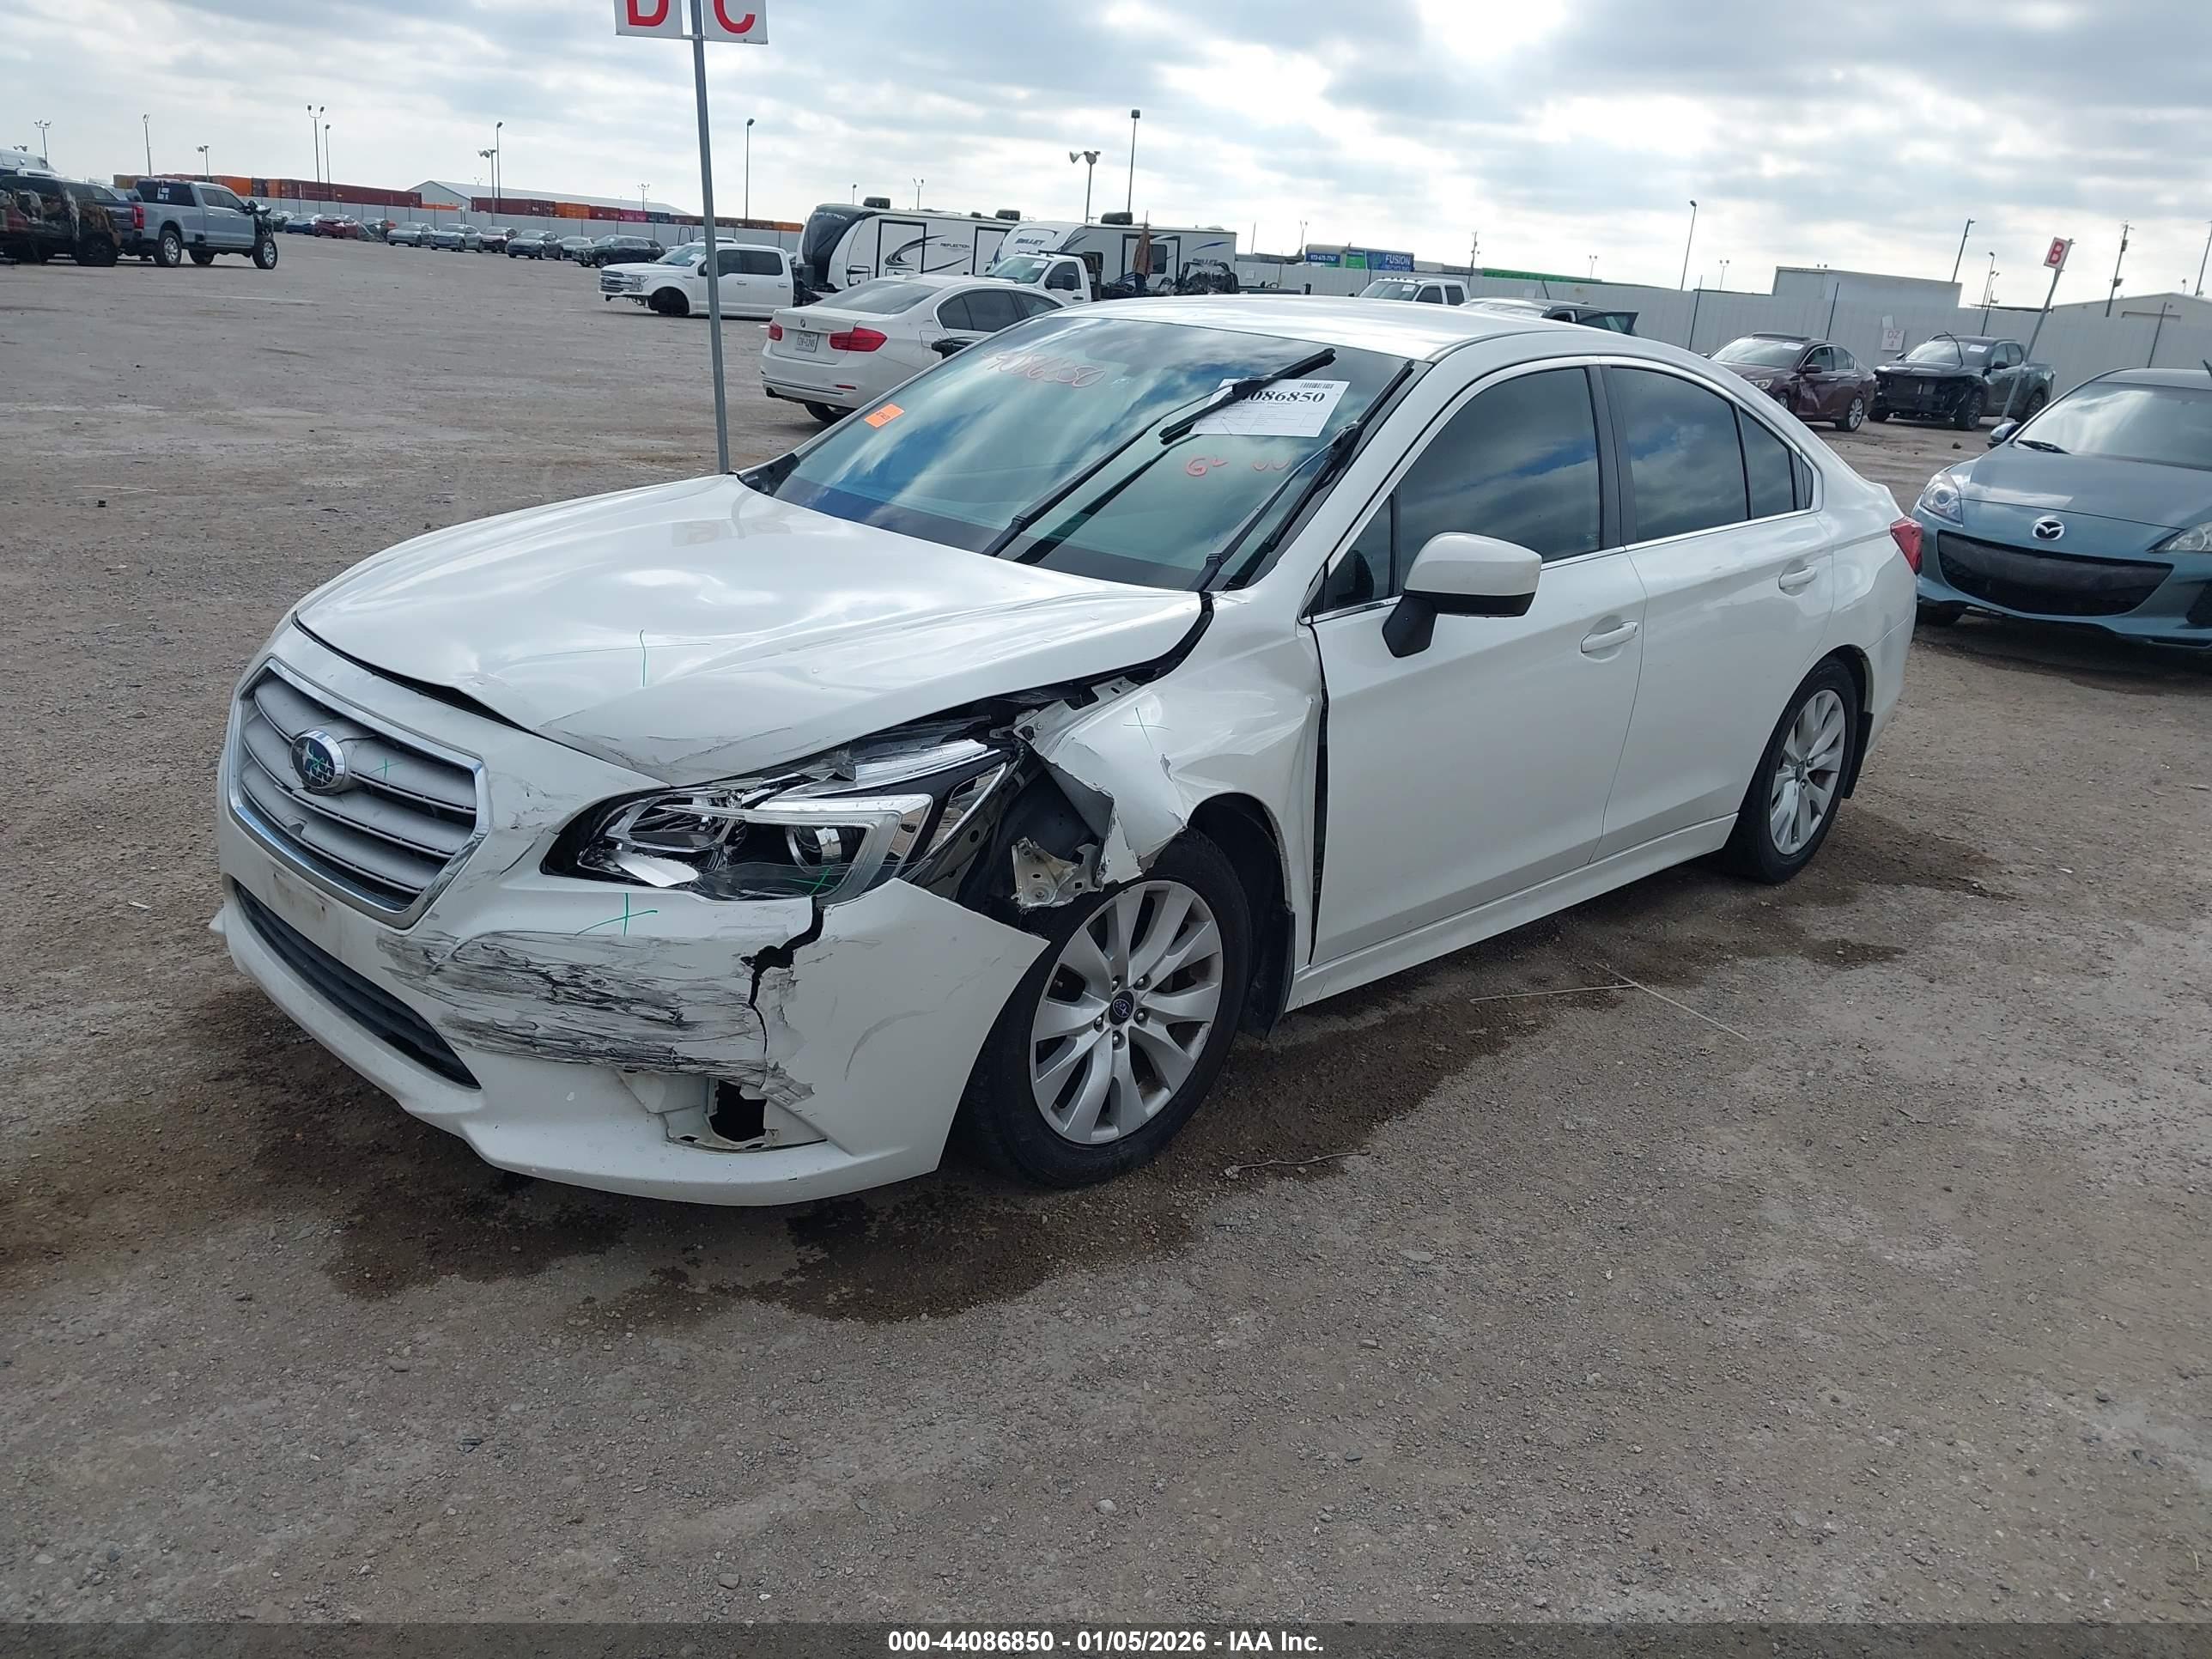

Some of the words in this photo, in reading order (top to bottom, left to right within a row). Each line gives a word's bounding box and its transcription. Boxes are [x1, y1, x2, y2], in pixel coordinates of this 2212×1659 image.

[1385, 253, 1412, 265] FUSION
[2048, 241, 2064, 264] B
[1243, 390, 1326, 403] 086850
